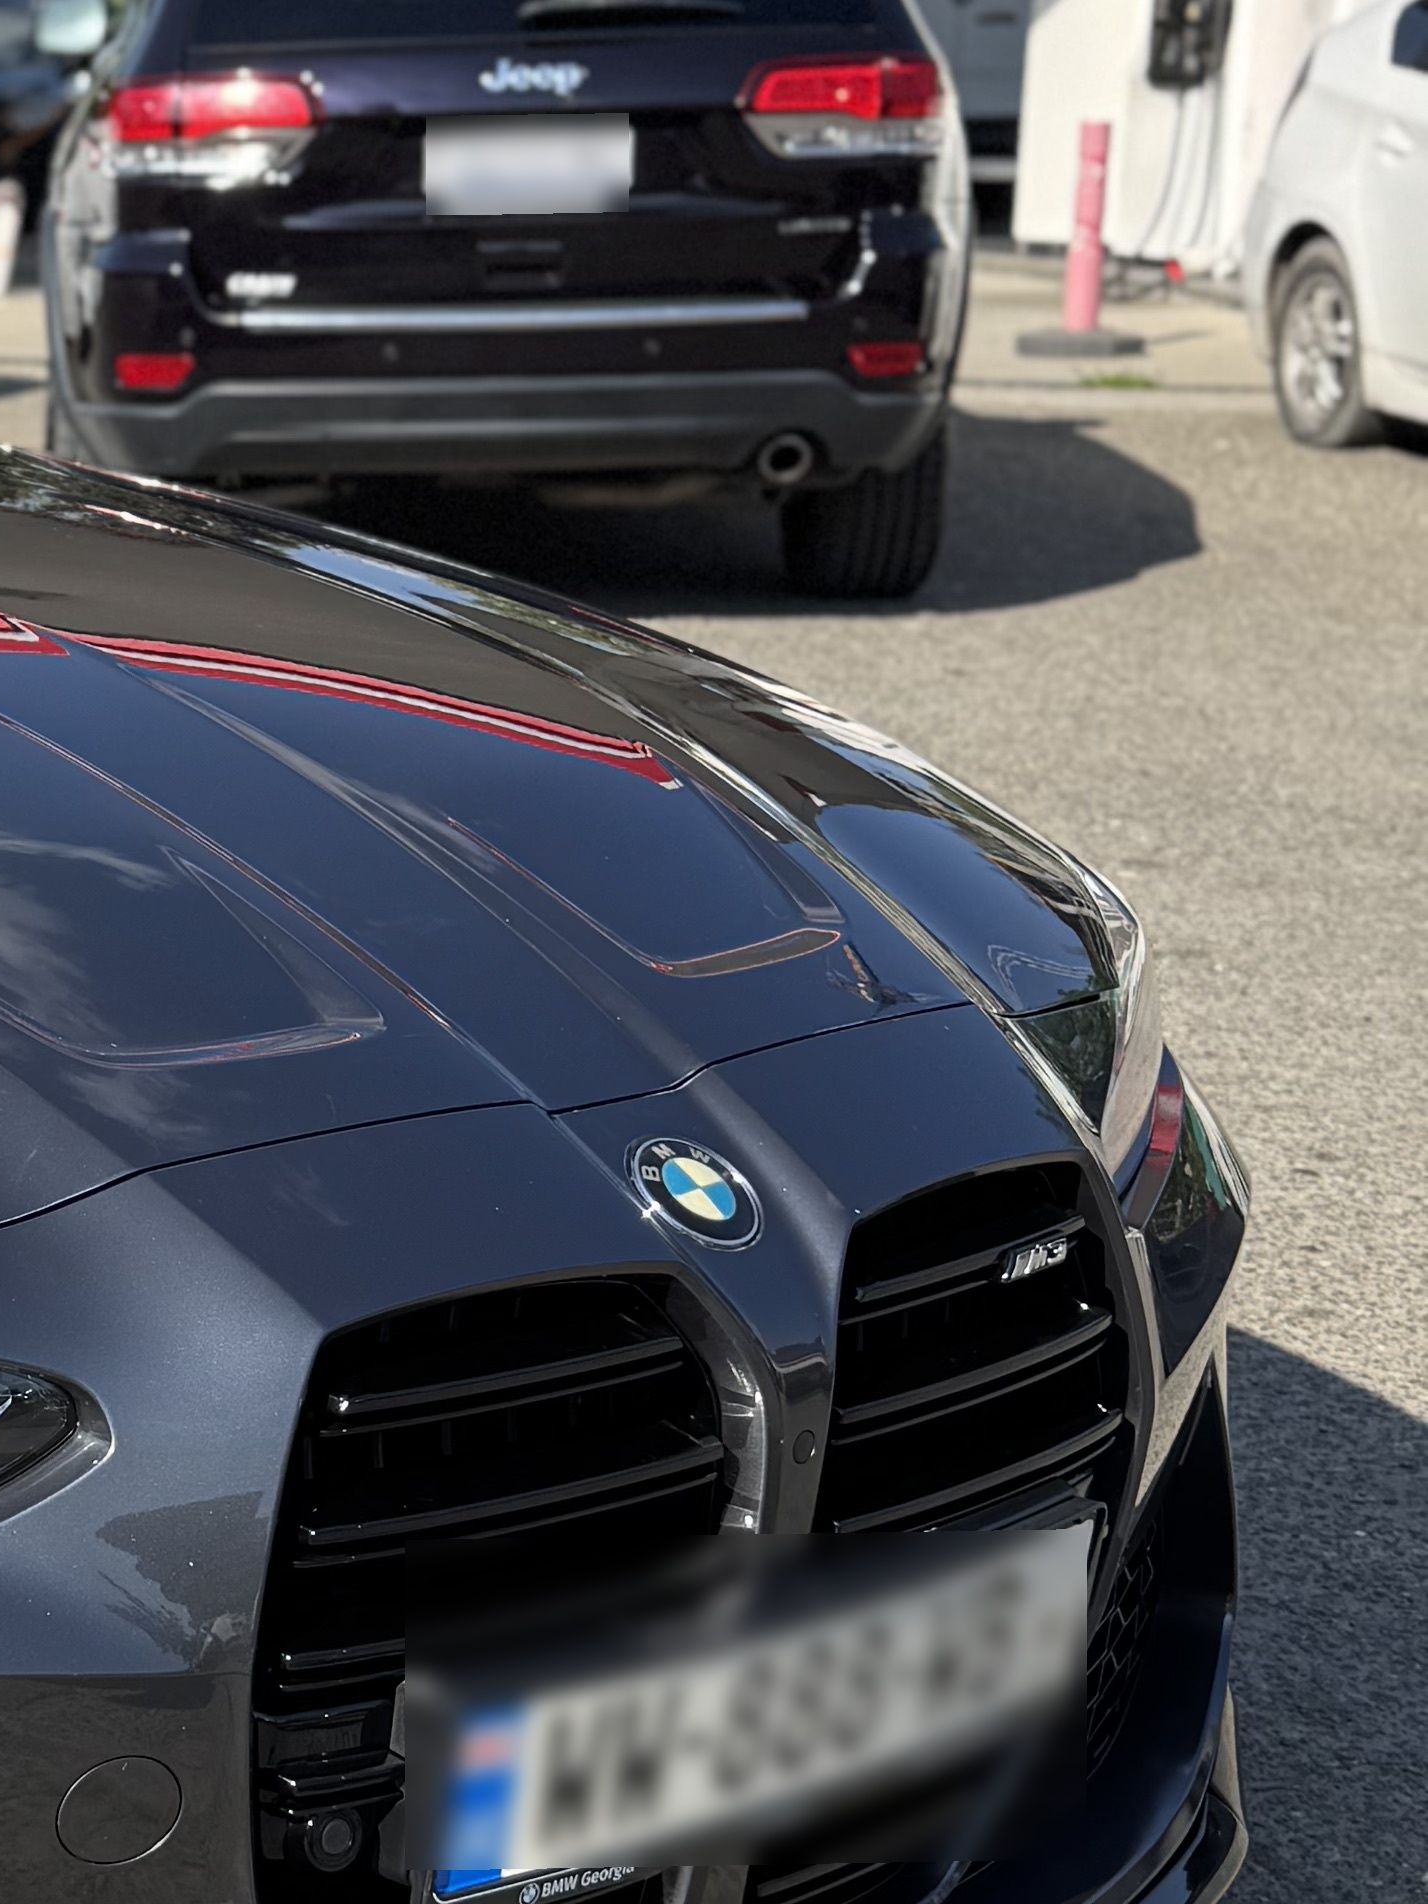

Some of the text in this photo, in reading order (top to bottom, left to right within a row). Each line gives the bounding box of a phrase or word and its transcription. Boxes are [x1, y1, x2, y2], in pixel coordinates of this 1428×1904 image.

[478, 57, 590, 96] Jeep
[640, 1142, 711, 1183] BMW
[541, 1866, 635, 1898] BMW Georgia
